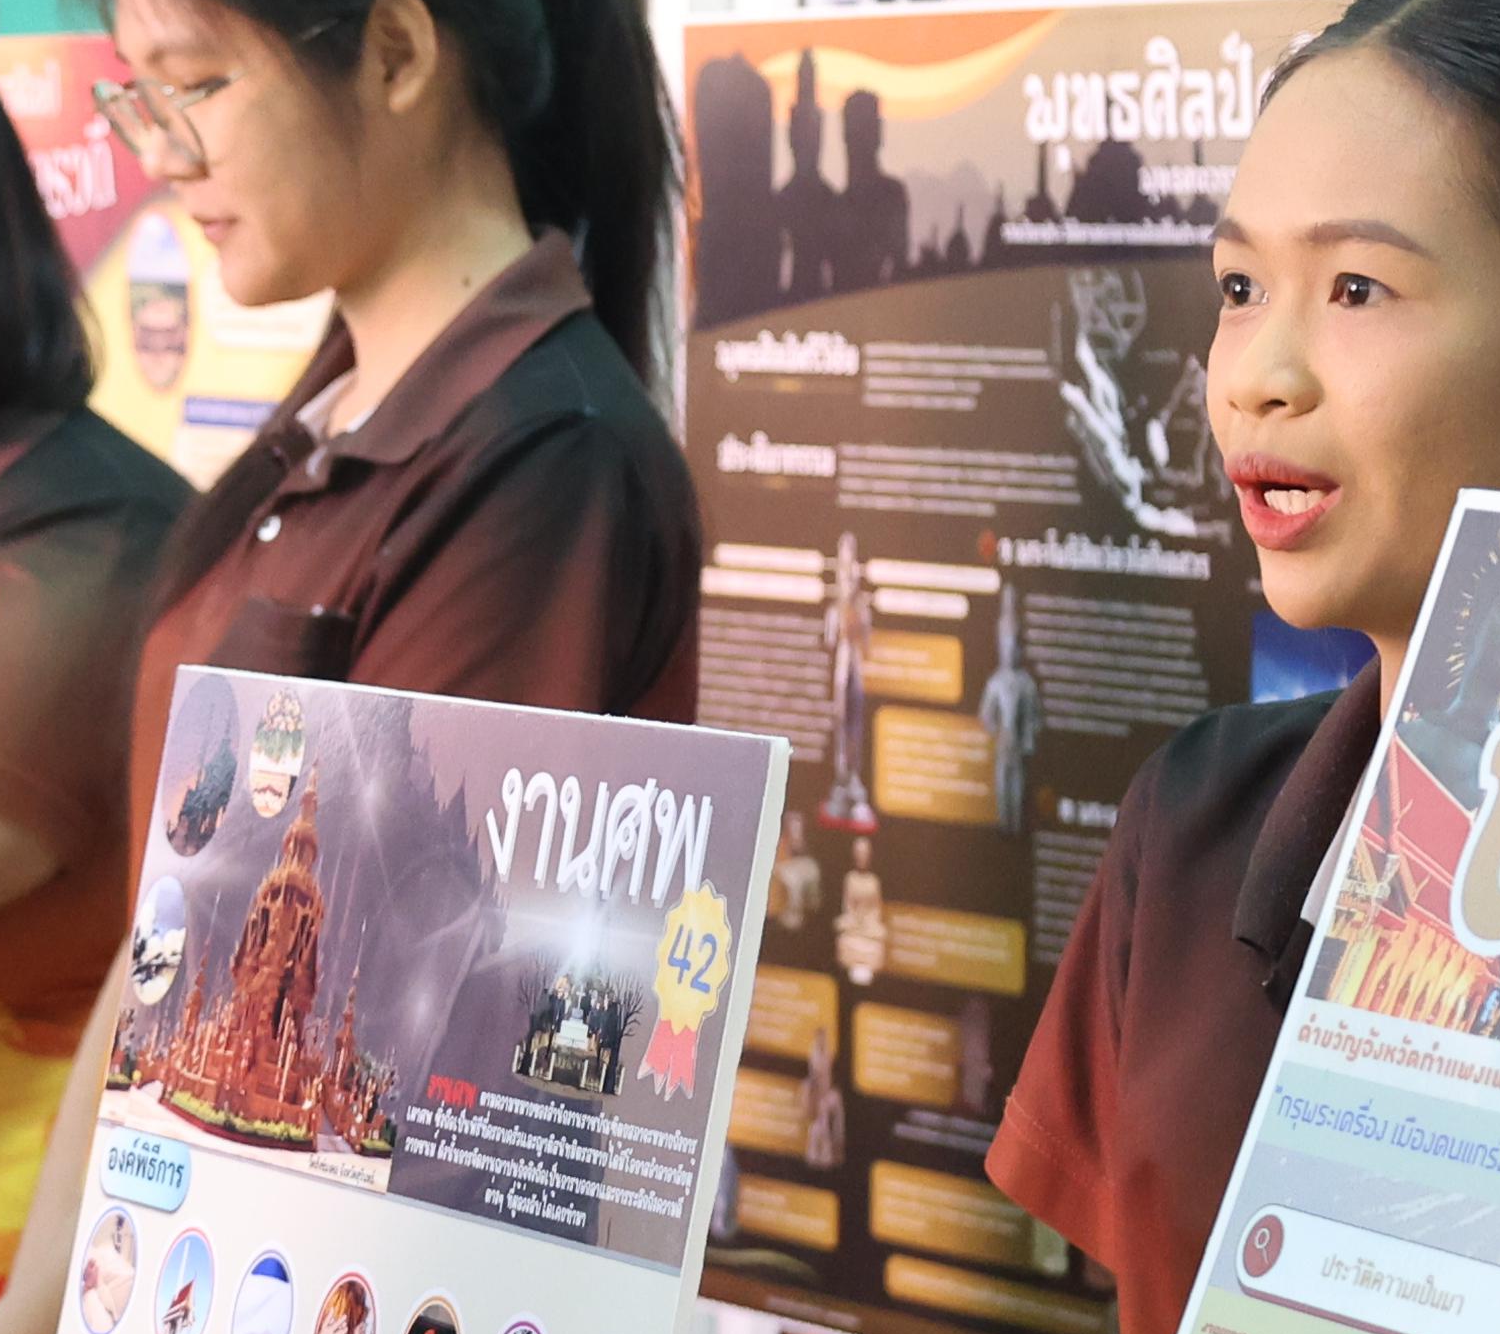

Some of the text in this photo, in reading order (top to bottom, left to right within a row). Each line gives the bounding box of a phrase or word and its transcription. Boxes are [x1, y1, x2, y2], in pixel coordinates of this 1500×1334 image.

[1024, 31, 1274, 172] พุทธศิลป์
[486, 766, 716, 910] งานศพ
[666, 923, 719, 995] 42
[108, 1136, 185, 1190] องค์พิธีการ
